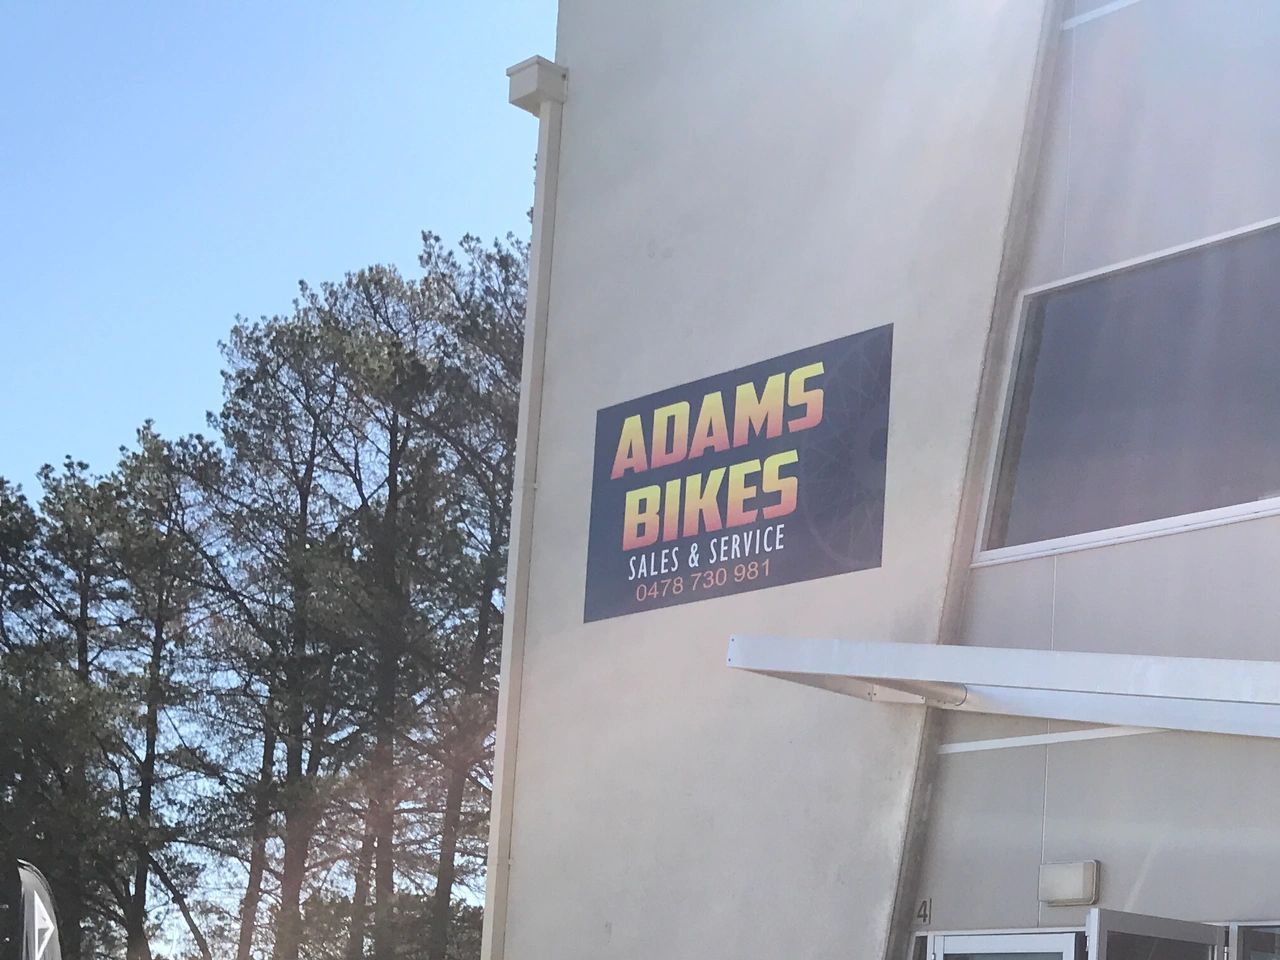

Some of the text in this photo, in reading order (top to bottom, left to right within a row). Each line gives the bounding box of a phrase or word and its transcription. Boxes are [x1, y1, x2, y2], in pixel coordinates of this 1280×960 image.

[611, 361, 825, 480] ADAMS
[622, 449, 799, 551] BIKES
[628, 524, 785, 581] SALES & SERVICE
[636, 558, 771, 602] 0478 730 981
